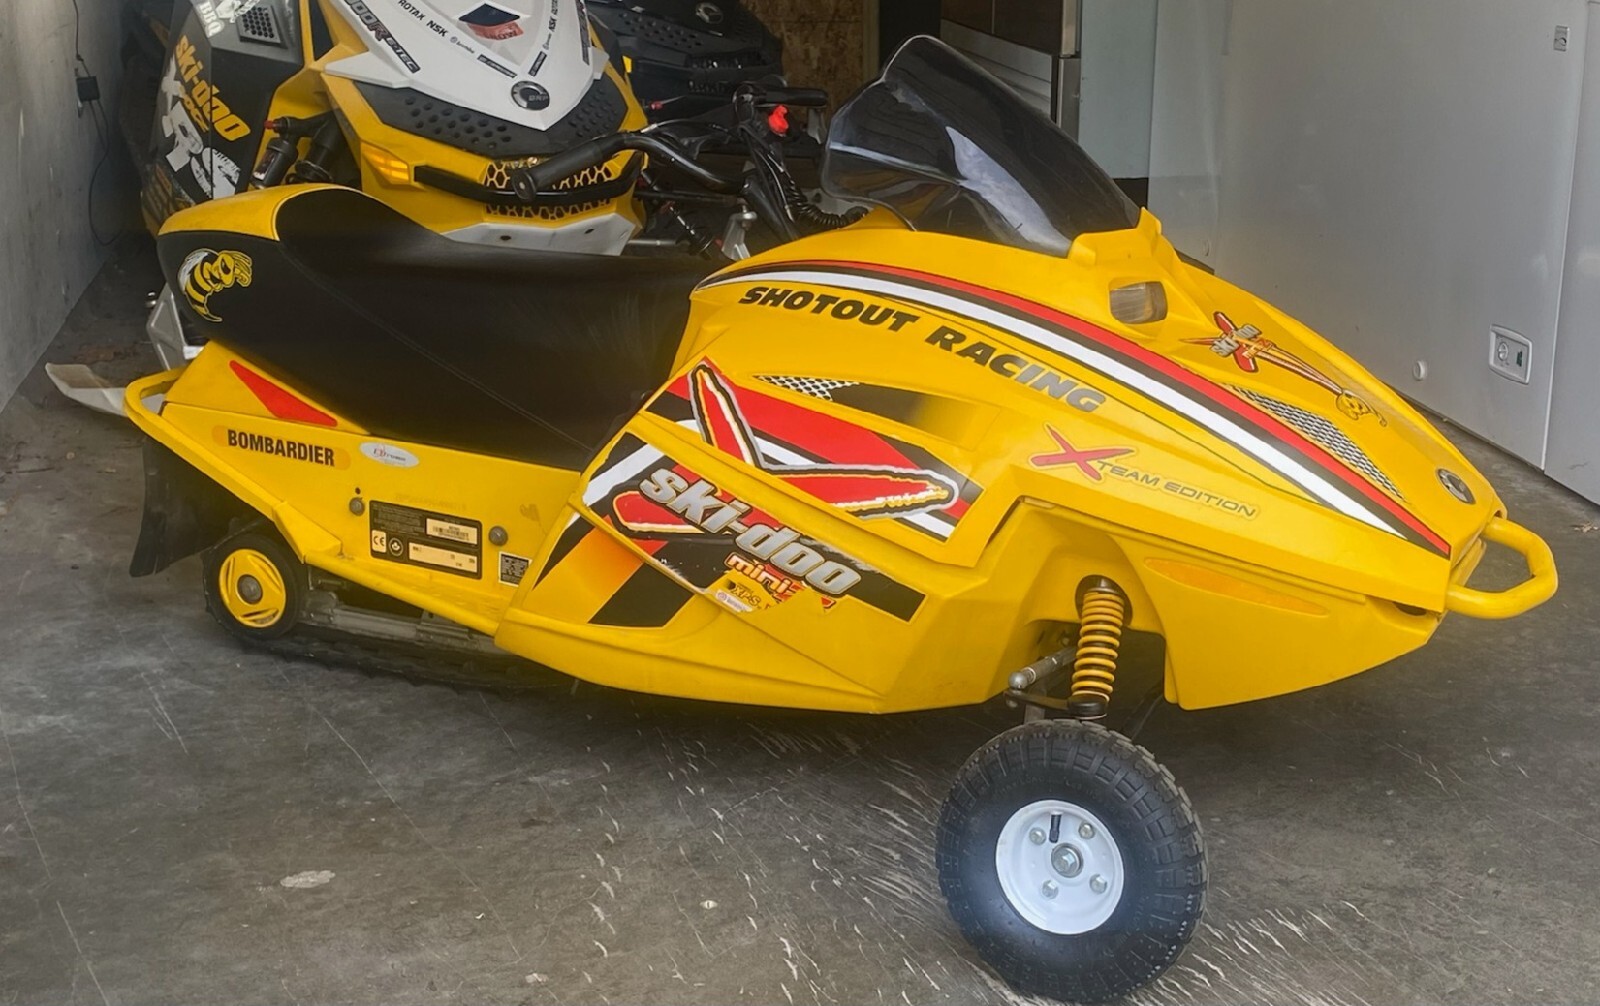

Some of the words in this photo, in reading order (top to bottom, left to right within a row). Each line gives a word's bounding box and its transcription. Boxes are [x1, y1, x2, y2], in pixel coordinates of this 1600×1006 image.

[426, 20, 448, 37] NSK
[738, 286, 920, 332] SHOTOUT
[925, 325, 1107, 413] RACING
[227, 429, 335, 467] BOMBARDIER
[1098, 460, 1160, 487] TEAM
[1164, 481, 1257, 518] EDITION
[640, 467, 862, 596] ski-doo
